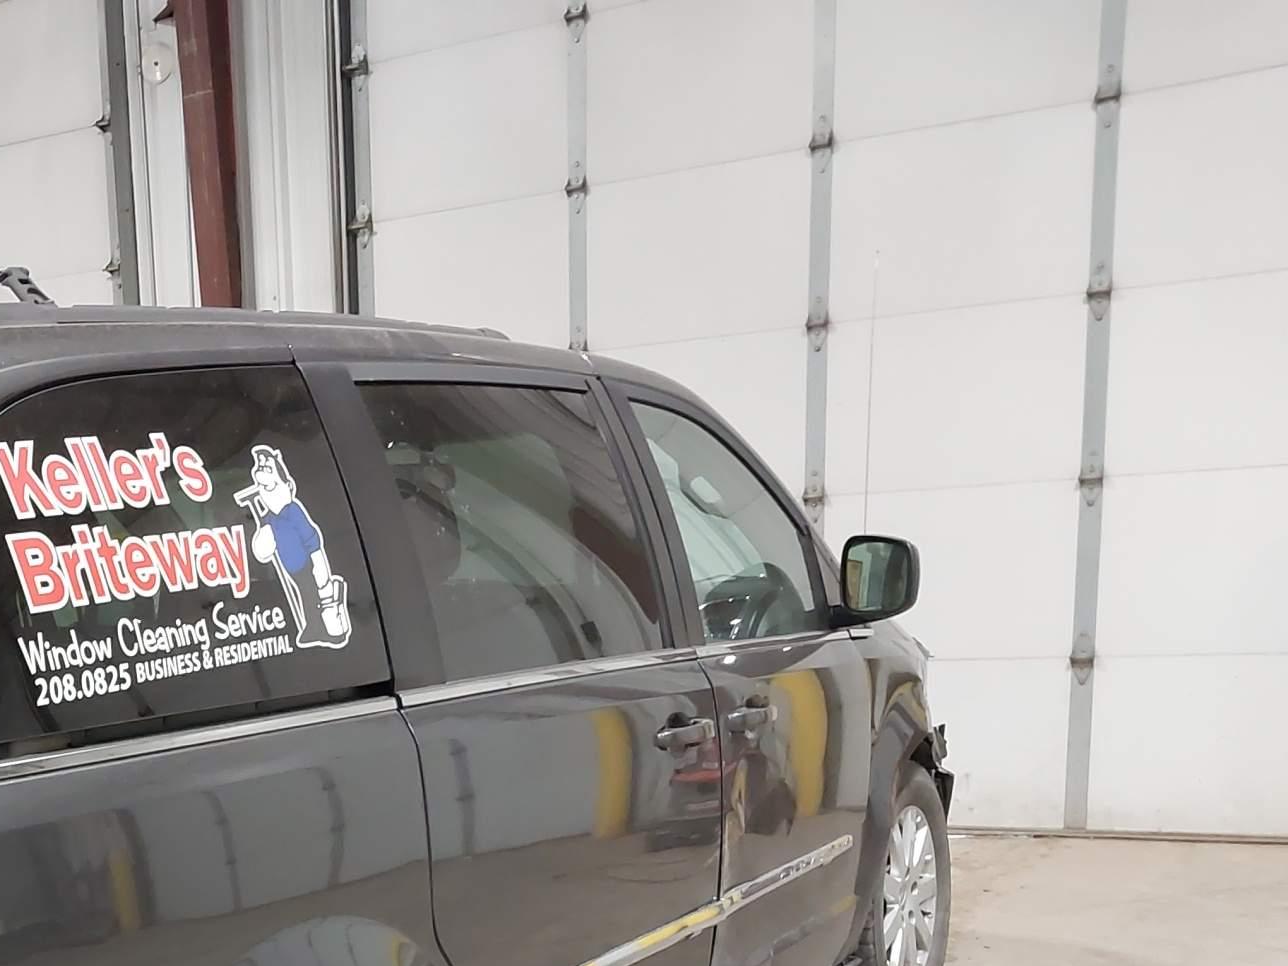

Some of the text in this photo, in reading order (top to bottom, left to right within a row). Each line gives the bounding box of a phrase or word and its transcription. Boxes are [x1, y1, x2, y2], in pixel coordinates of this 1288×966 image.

[5, 523, 249, 614] Briteway
[18, 602, 286, 676] Window Cleaning Service
[34, 634, 293, 707] 208.0825 BUSINESS & RESIDENTIAL
